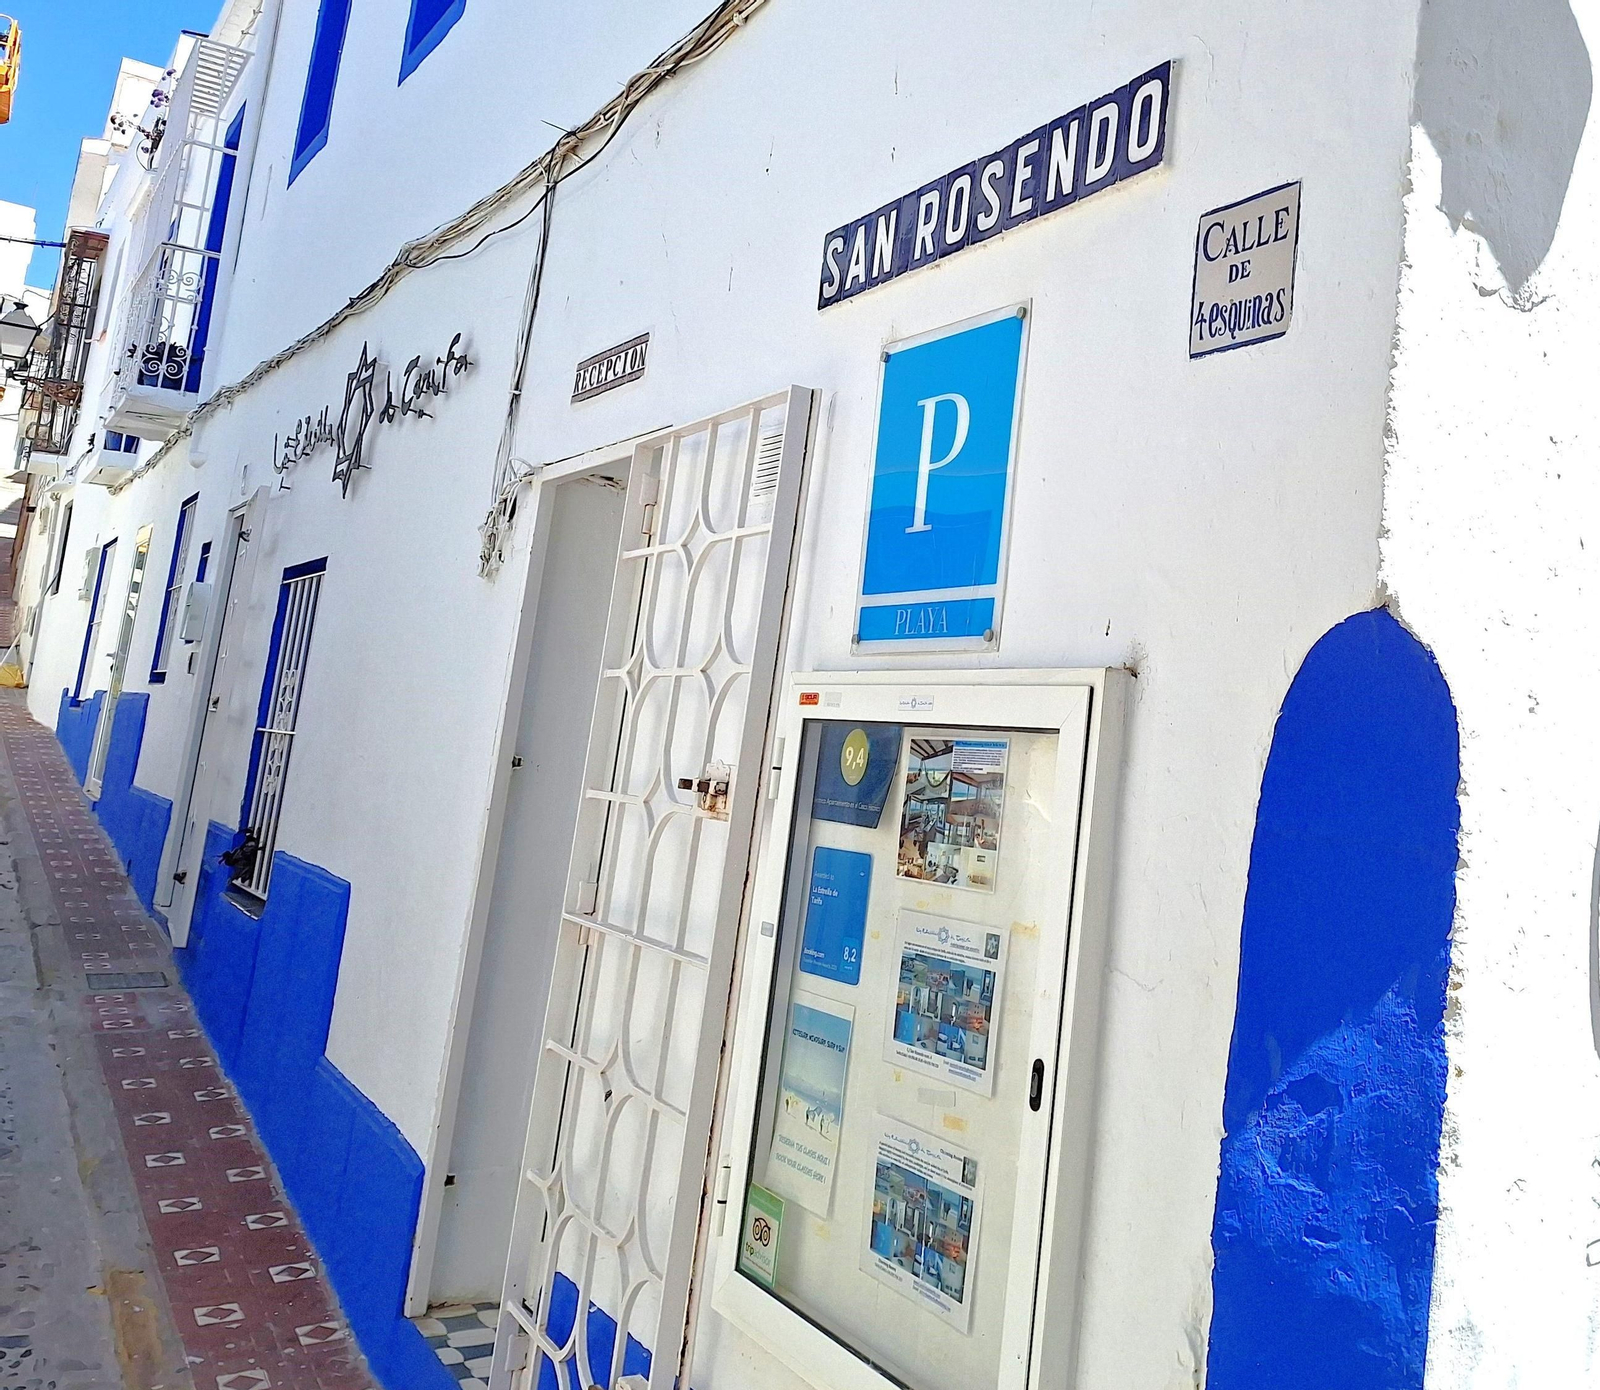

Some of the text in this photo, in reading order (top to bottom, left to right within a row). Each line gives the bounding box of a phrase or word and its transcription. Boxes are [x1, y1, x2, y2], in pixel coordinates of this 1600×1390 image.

[822, 78, 1164, 300] SAN ROSENDO
[1202, 206, 1291, 262] CALLE
[1228, 259, 1252, 283] DE
[573, 342, 649, 394] RECEPCION
[905, 391, 971, 535] P
[894, 606, 949, 636] PLAYA
[845, 746, 865, 770] 9,4
[811, 896, 823, 905] Tarifa
[812, 885, 839, 897] La Estrella de
[843, 946, 857, 963] 8,2
[745, 1241, 771, 1267] tripadvisor
